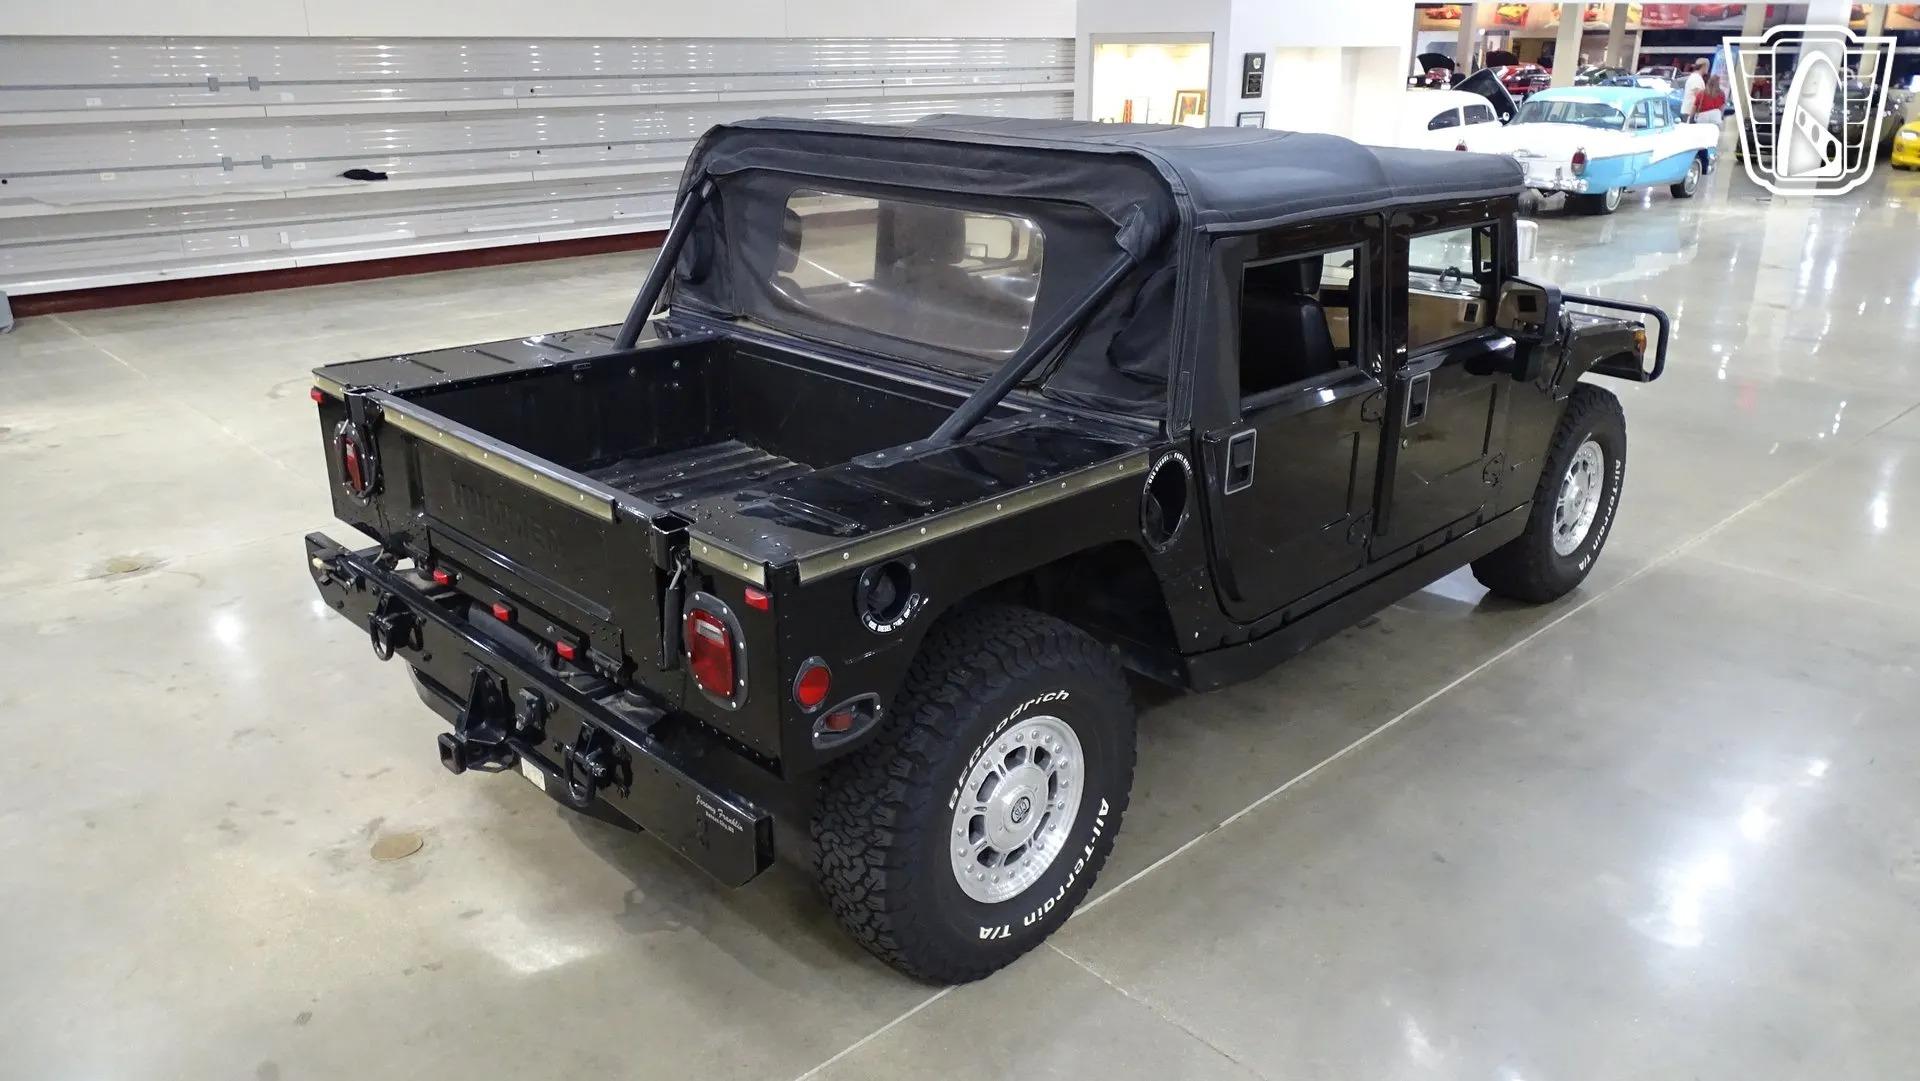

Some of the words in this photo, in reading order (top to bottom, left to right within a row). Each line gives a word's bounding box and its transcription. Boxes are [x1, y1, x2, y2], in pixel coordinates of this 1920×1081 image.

[1592, 459, 1622, 550] All-Terrain
[1578, 553, 1592, 571] T/A
[948, 689, 1070, 810] BFGoodrich
[1023, 797, 1110, 928] All-Terrain
[978, 925, 1012, 941] T/A
